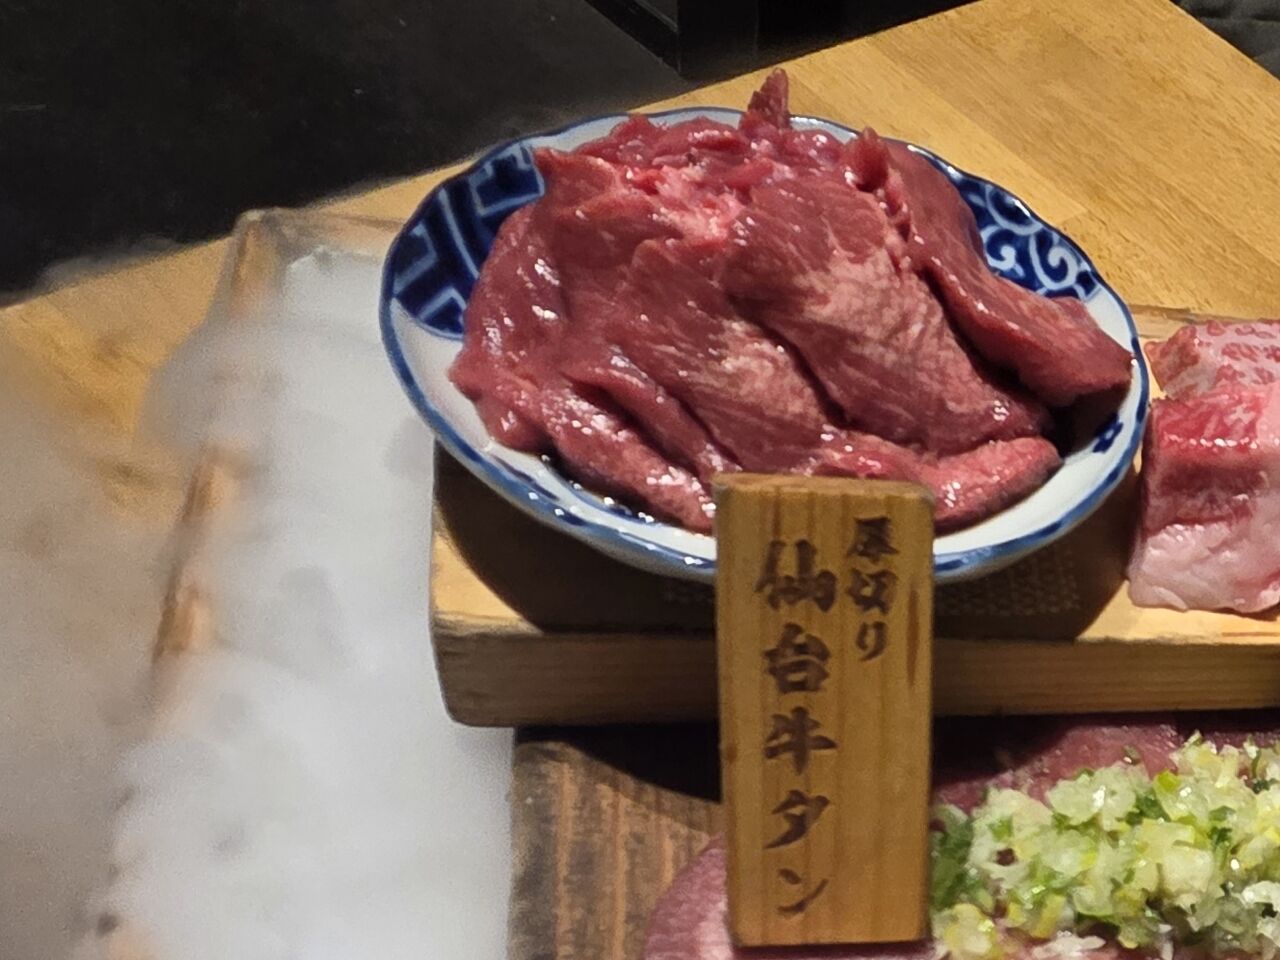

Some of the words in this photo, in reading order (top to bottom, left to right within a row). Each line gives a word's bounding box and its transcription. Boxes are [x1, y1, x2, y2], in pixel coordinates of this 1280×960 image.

[845, 516, 899, 663] 厚切り
[755, 538, 839, 919] 仙台牛タン
